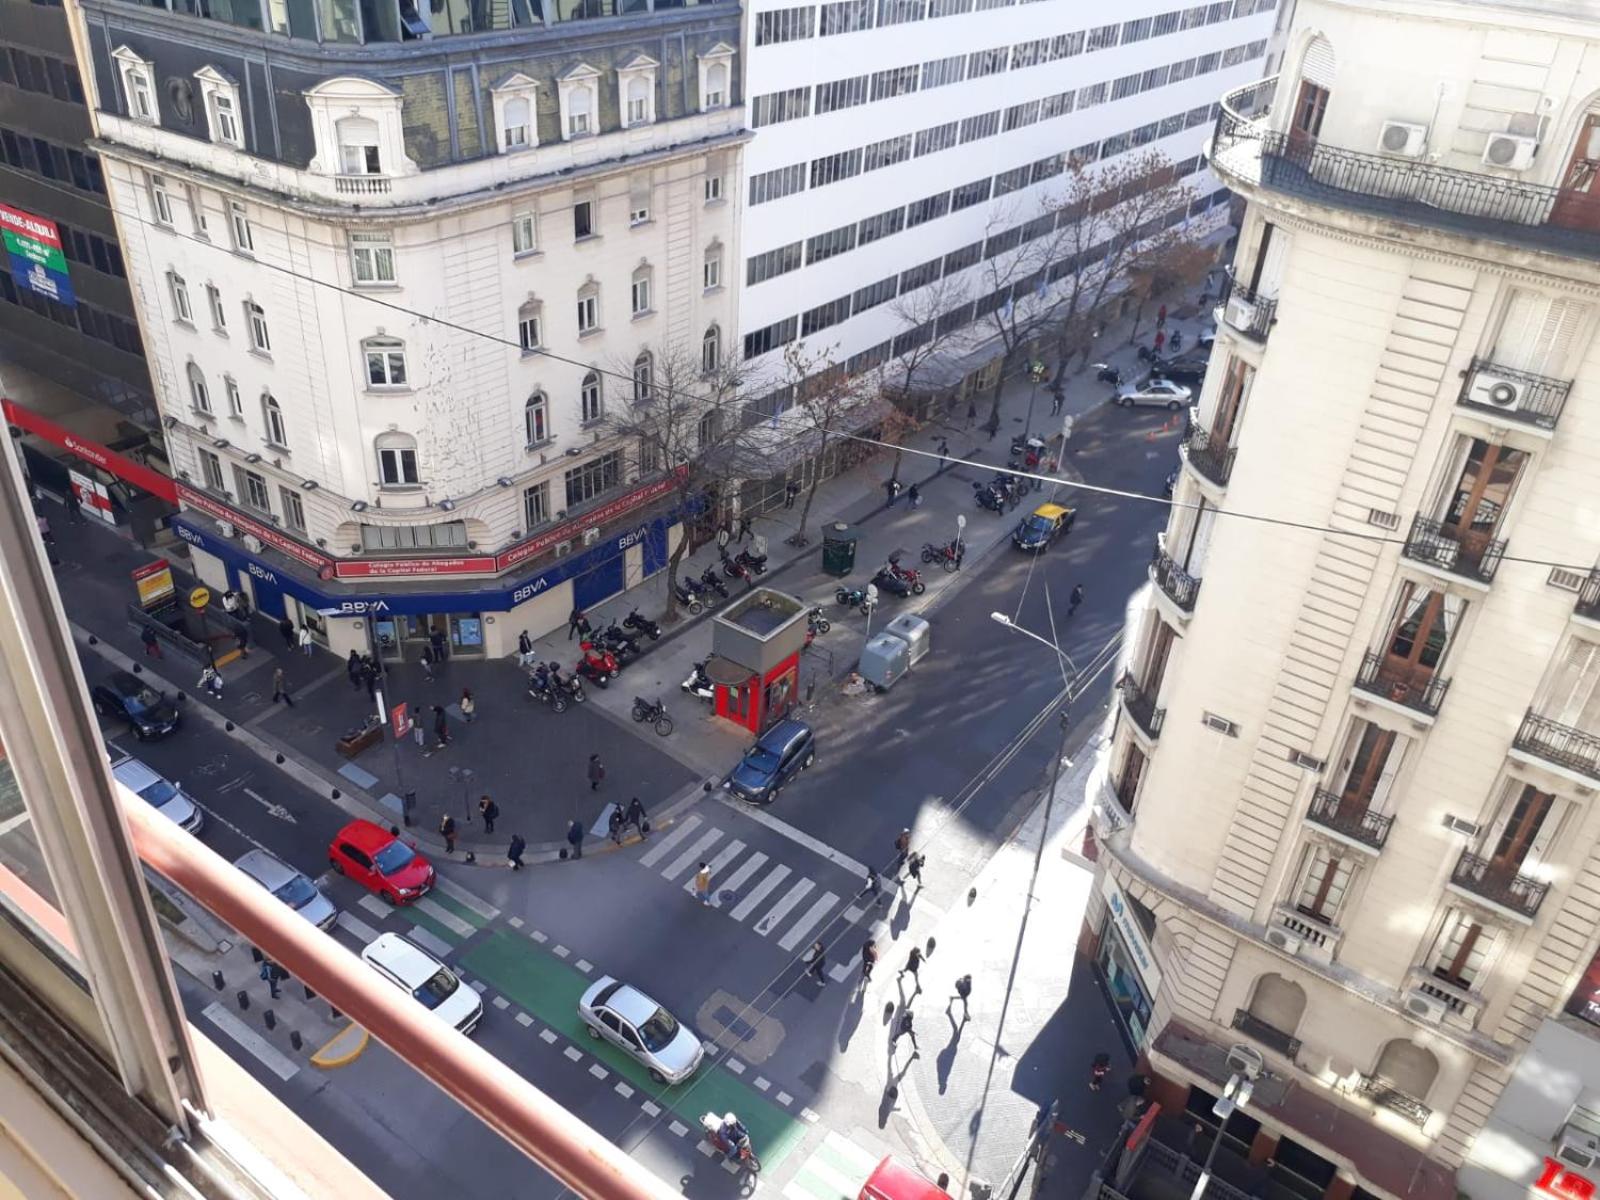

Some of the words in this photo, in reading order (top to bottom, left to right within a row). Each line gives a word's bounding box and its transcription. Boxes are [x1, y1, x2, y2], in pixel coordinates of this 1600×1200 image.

[177, 525, 204, 547] BBVA
[618, 527, 647, 550] BBVA
[248, 562, 279, 584] BBVA
[514, 577, 548, 603] BBVA
